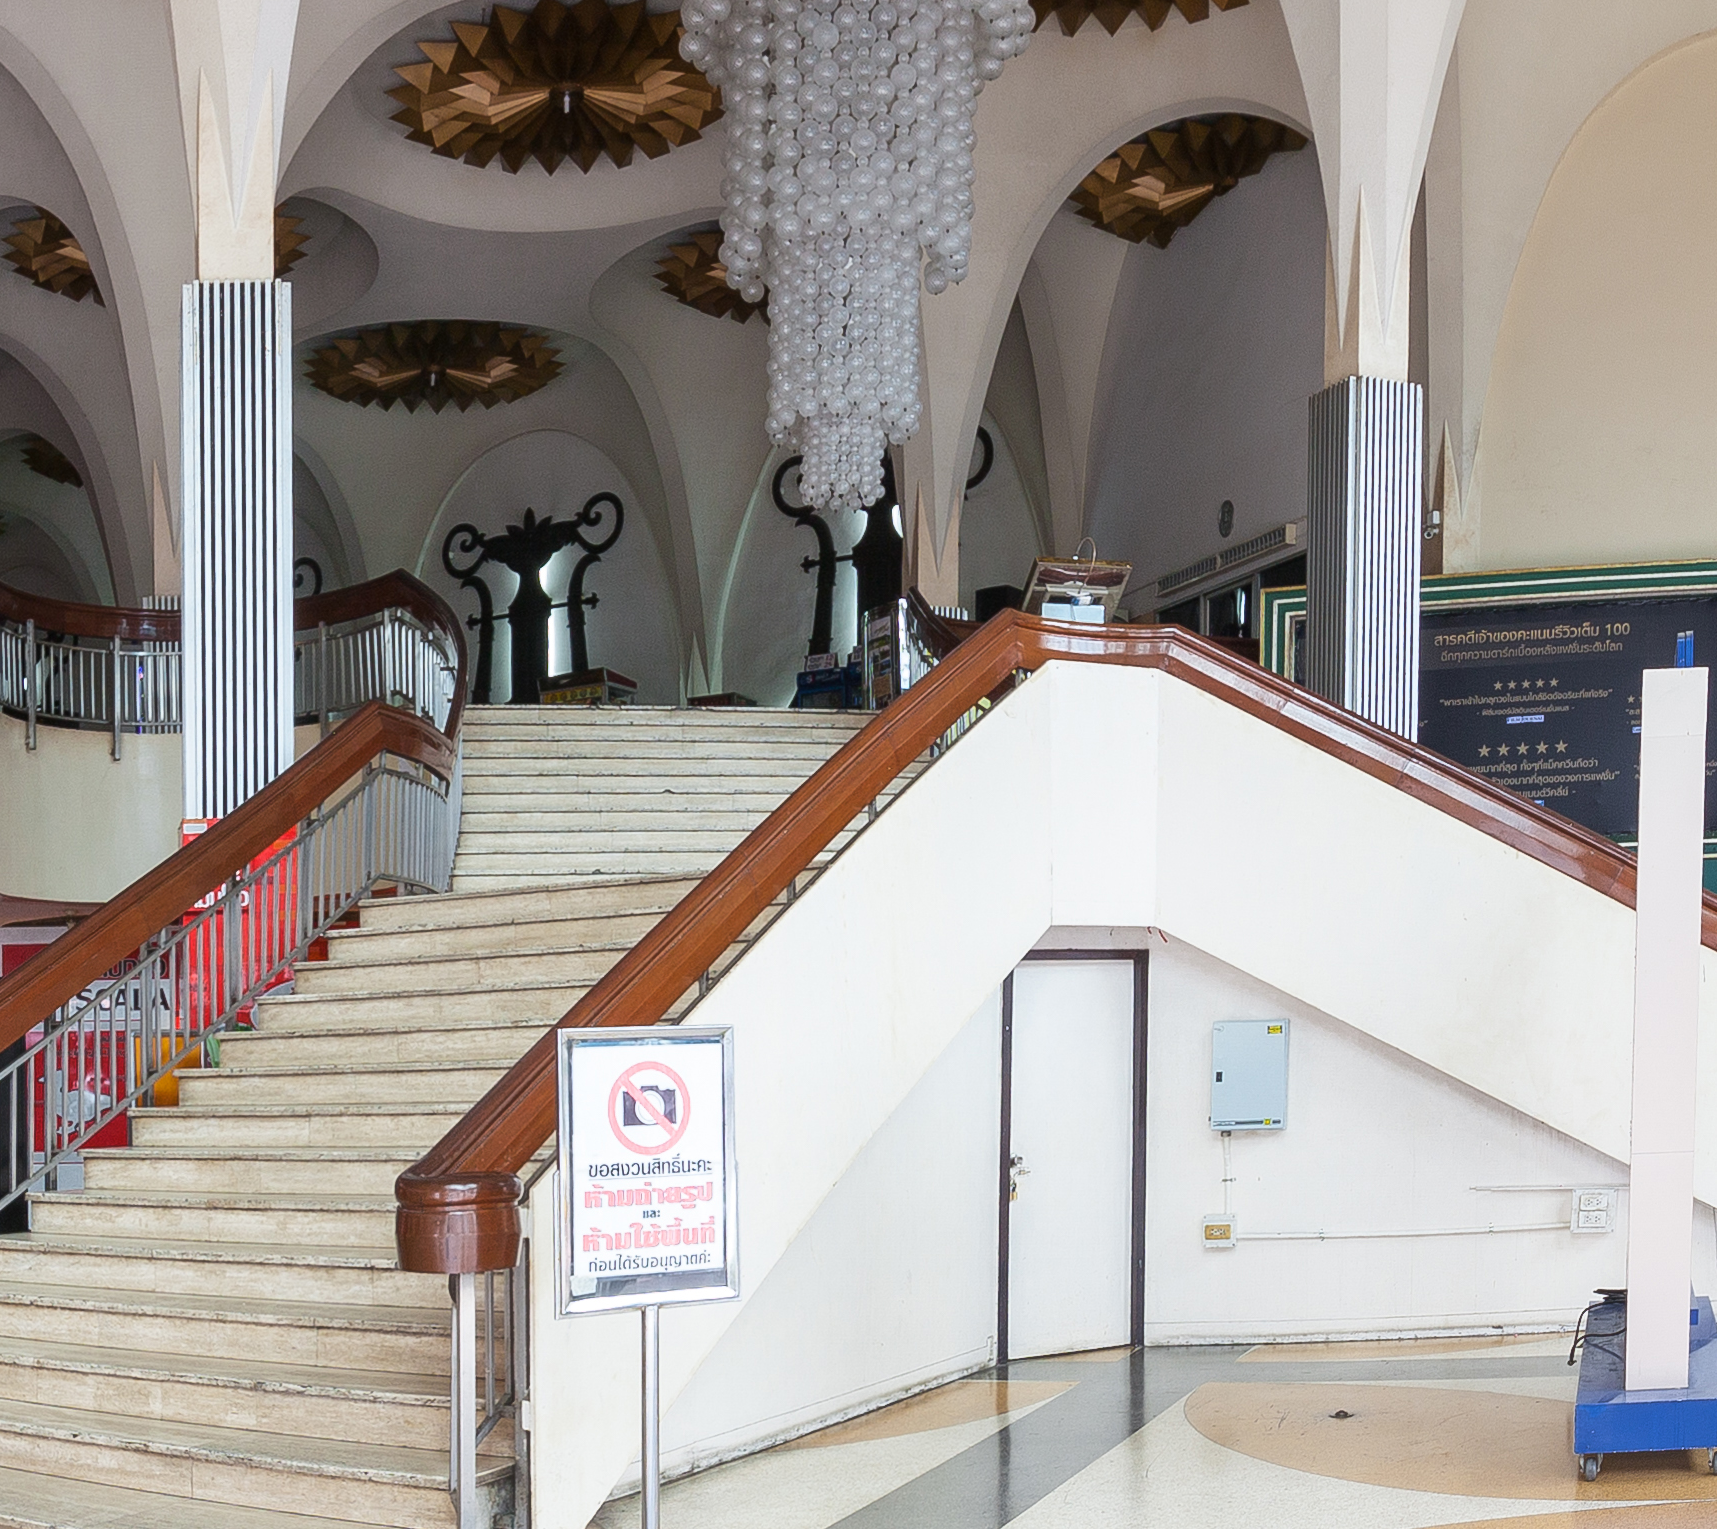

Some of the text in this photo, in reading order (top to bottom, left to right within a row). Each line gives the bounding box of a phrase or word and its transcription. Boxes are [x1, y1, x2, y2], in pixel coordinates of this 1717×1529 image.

[1605, 622, 1631, 636] 100
[588, 1153, 713, 1178] ขอสงวนสิทธิ์นะคะ
[584, 1181, 713, 1209] ห้ามถ่ายรูป
[643, 1209, 661, 1219] และ
[582, 1215, 716, 1252] ห้ามใช้พื้นที่
[588, 1249, 711, 1272] ก่อนได้รับอนุญาตค่ะ
